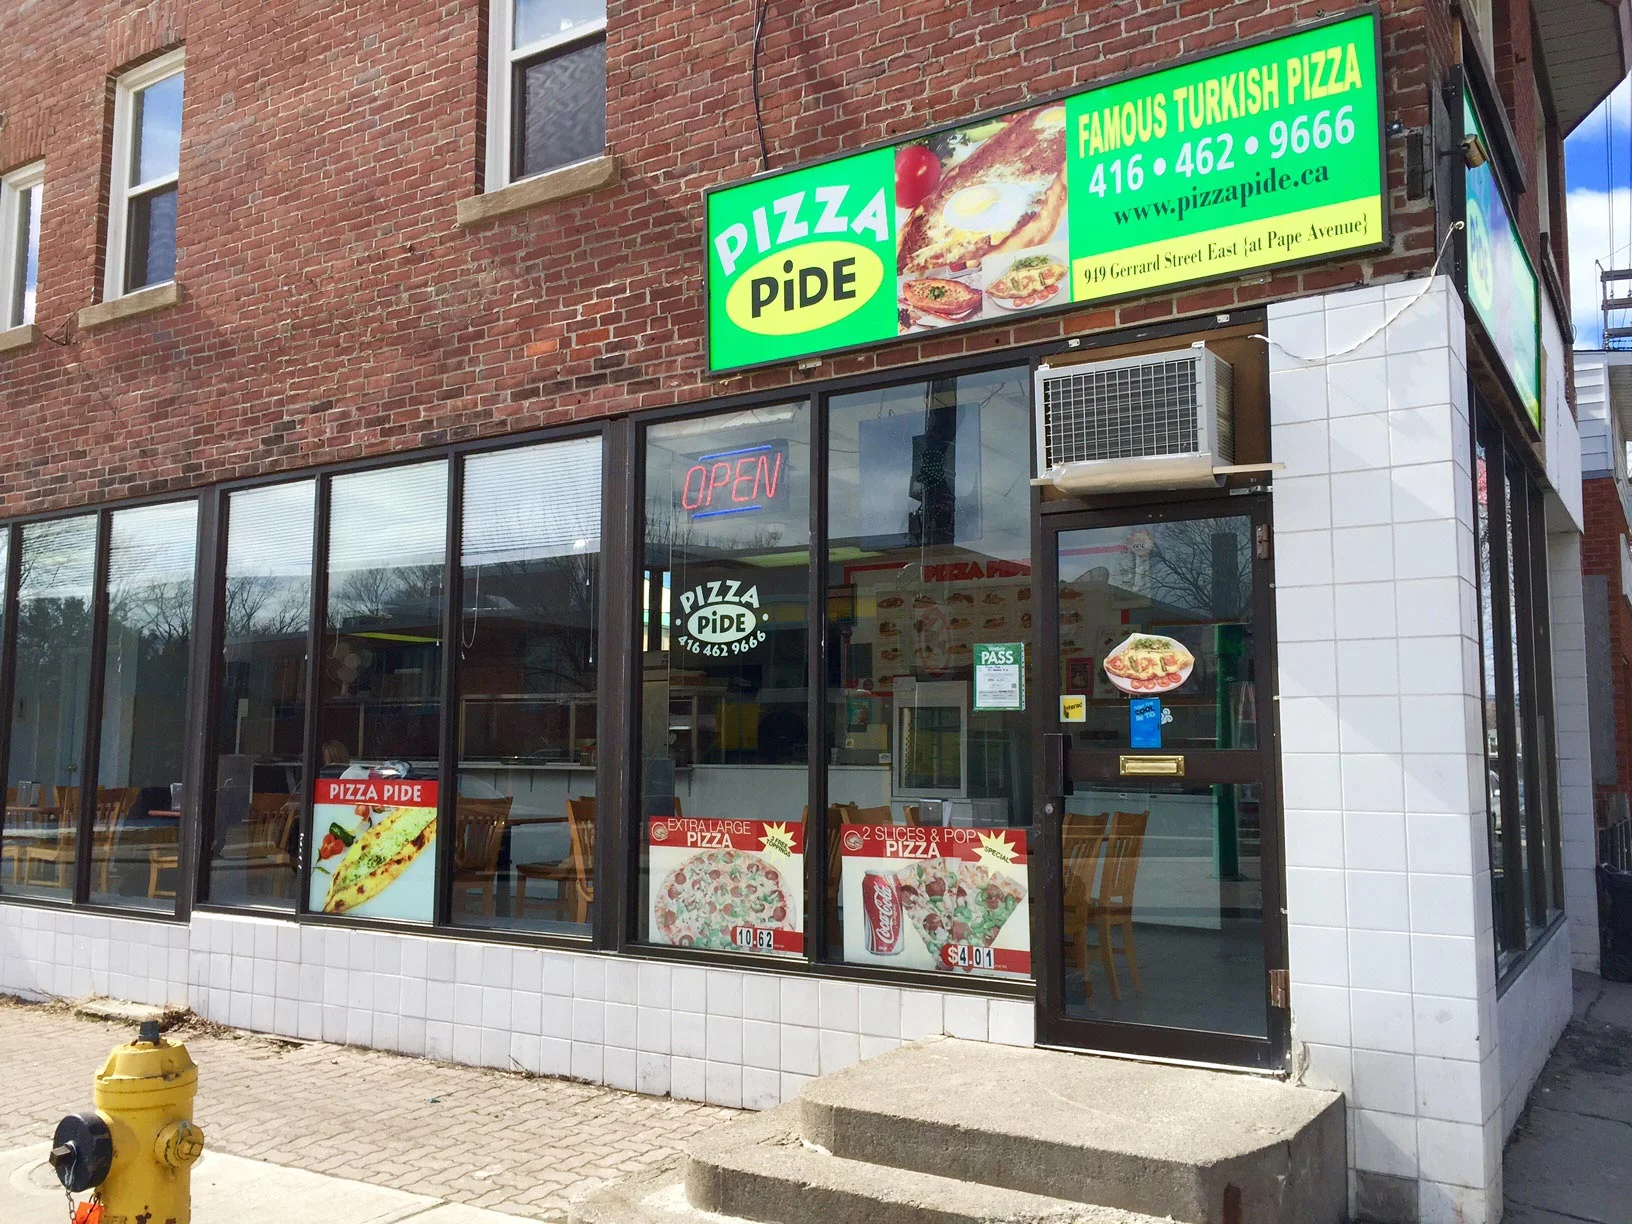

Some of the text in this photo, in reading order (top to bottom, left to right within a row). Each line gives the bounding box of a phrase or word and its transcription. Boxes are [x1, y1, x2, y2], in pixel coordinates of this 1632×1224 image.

[1078, 42, 1362, 158] FAMOUS TURKISH PIZZA
[1088, 105, 1356, 198] 416 462 9666
[1114, 164, 1329, 225] www.pizzapide.ca
[713, 184, 889, 277] PIZZA
[1110, 253, 1161, 280] Gerrard
[1164, 250, 1203, 269] Street
[1207, 242, 1238, 261] East
[1267, 230, 1303, 252] Pape
[681, 451, 782, 511] OPEN
[923, 561, 985, 583] PIZZA
[679, 580, 760, 615] PIZZA
[678, 630, 766, 657] 416 462 9666
[981, 650, 1014, 665] PASS
[329, 783, 422, 802] PIZZA PIDE
[667, 818, 751, 835] EXTRA LARGE
[862, 826, 977, 844] 2 SLICES & POP
[687, 831, 733, 849] PIZZA
[766, 838, 792, 857] TOPPINGS
[886, 840, 941, 858] PIZZA
[983, 845, 1010, 864] SPECIAL
[738, 930, 773, 949] 10.62
[947, 945, 993, 968] $4.01
